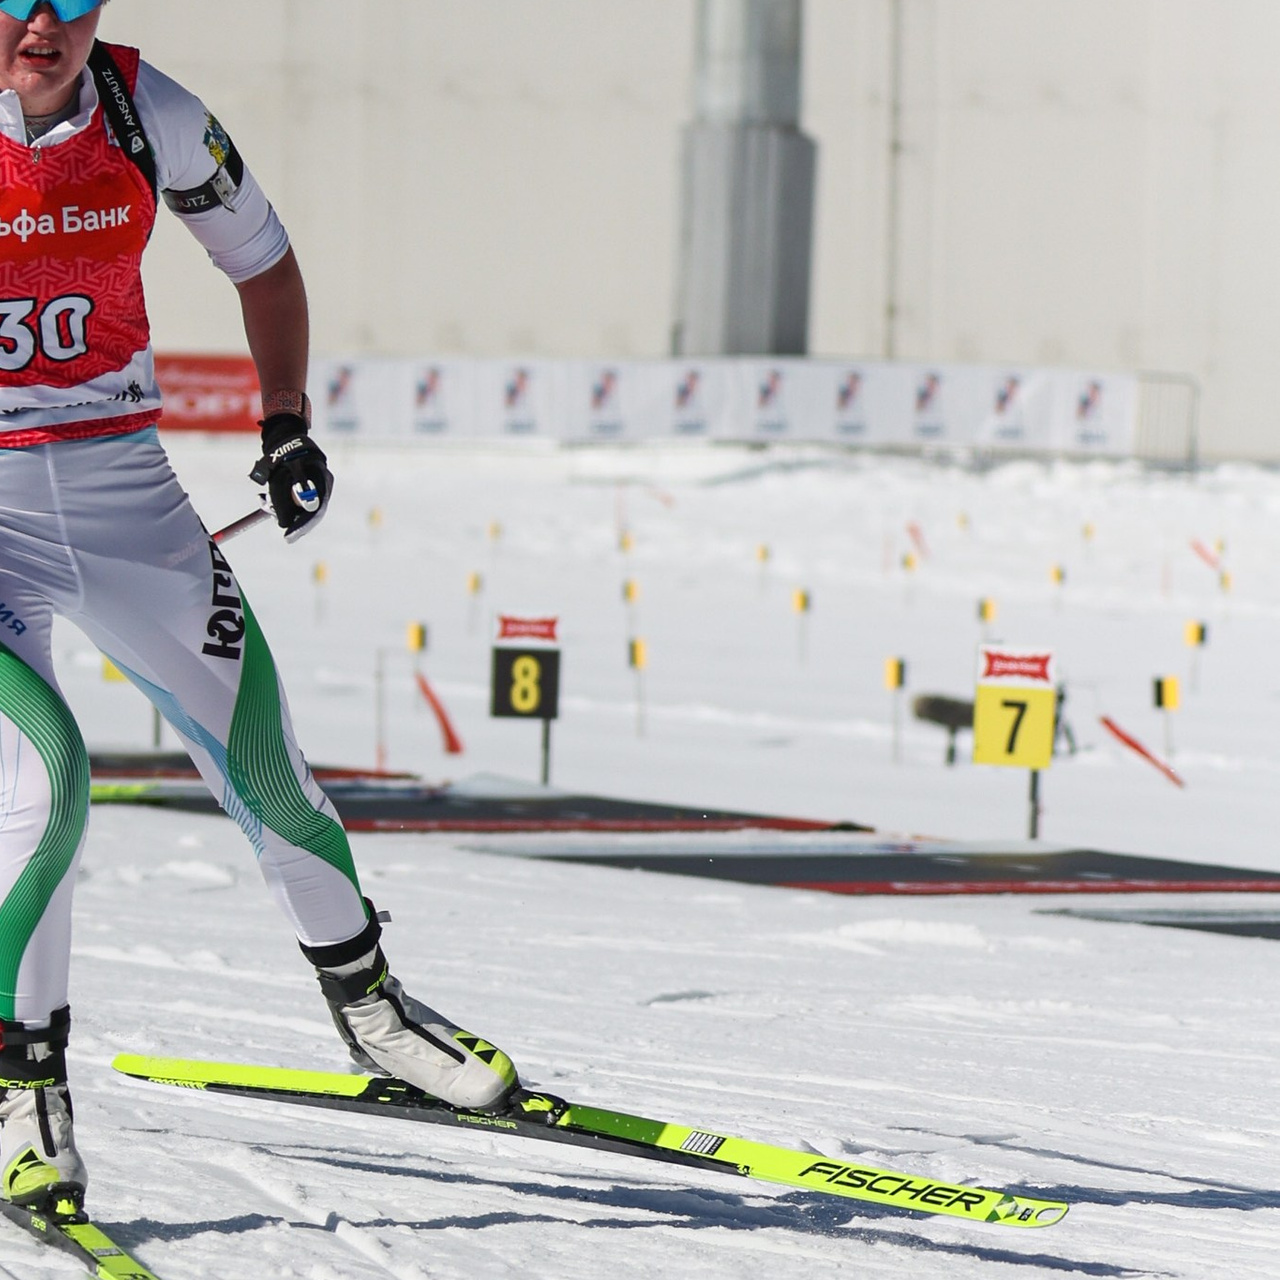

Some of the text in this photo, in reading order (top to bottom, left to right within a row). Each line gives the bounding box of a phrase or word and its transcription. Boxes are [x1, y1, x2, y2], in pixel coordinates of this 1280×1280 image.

[61, 204, 132, 234] Банк
[510, 654, 542, 714] 8
[1001, 698, 1029, 756] 7
[456, 1114, 519, 1131] FISCHER
[797, 1161, 987, 1213] FISCHER
